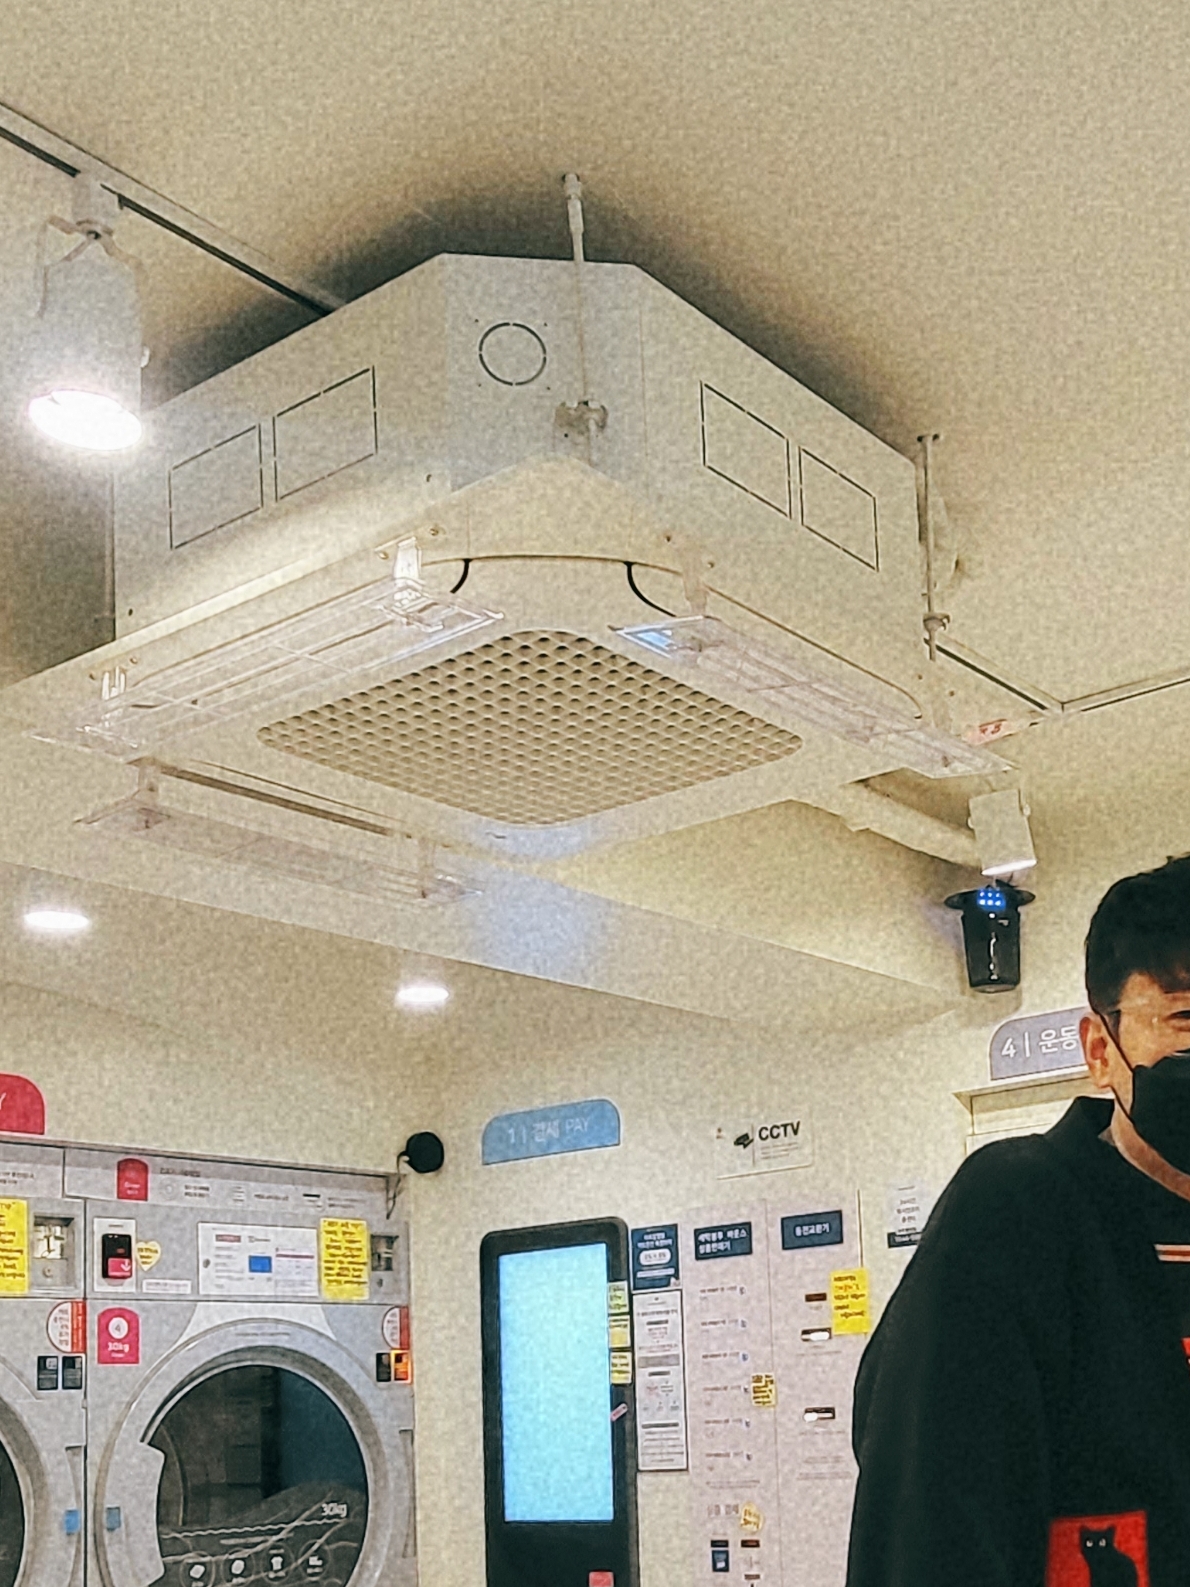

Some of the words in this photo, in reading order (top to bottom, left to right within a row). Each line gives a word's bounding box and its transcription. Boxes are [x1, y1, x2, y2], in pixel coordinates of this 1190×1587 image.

[1001, 1038, 1017, 1058] 4
[565, 1118, 589, 1134] PAY
[758, 1120, 801, 1141] CCTV
[321, 1503, 347, 1518] 30kg
